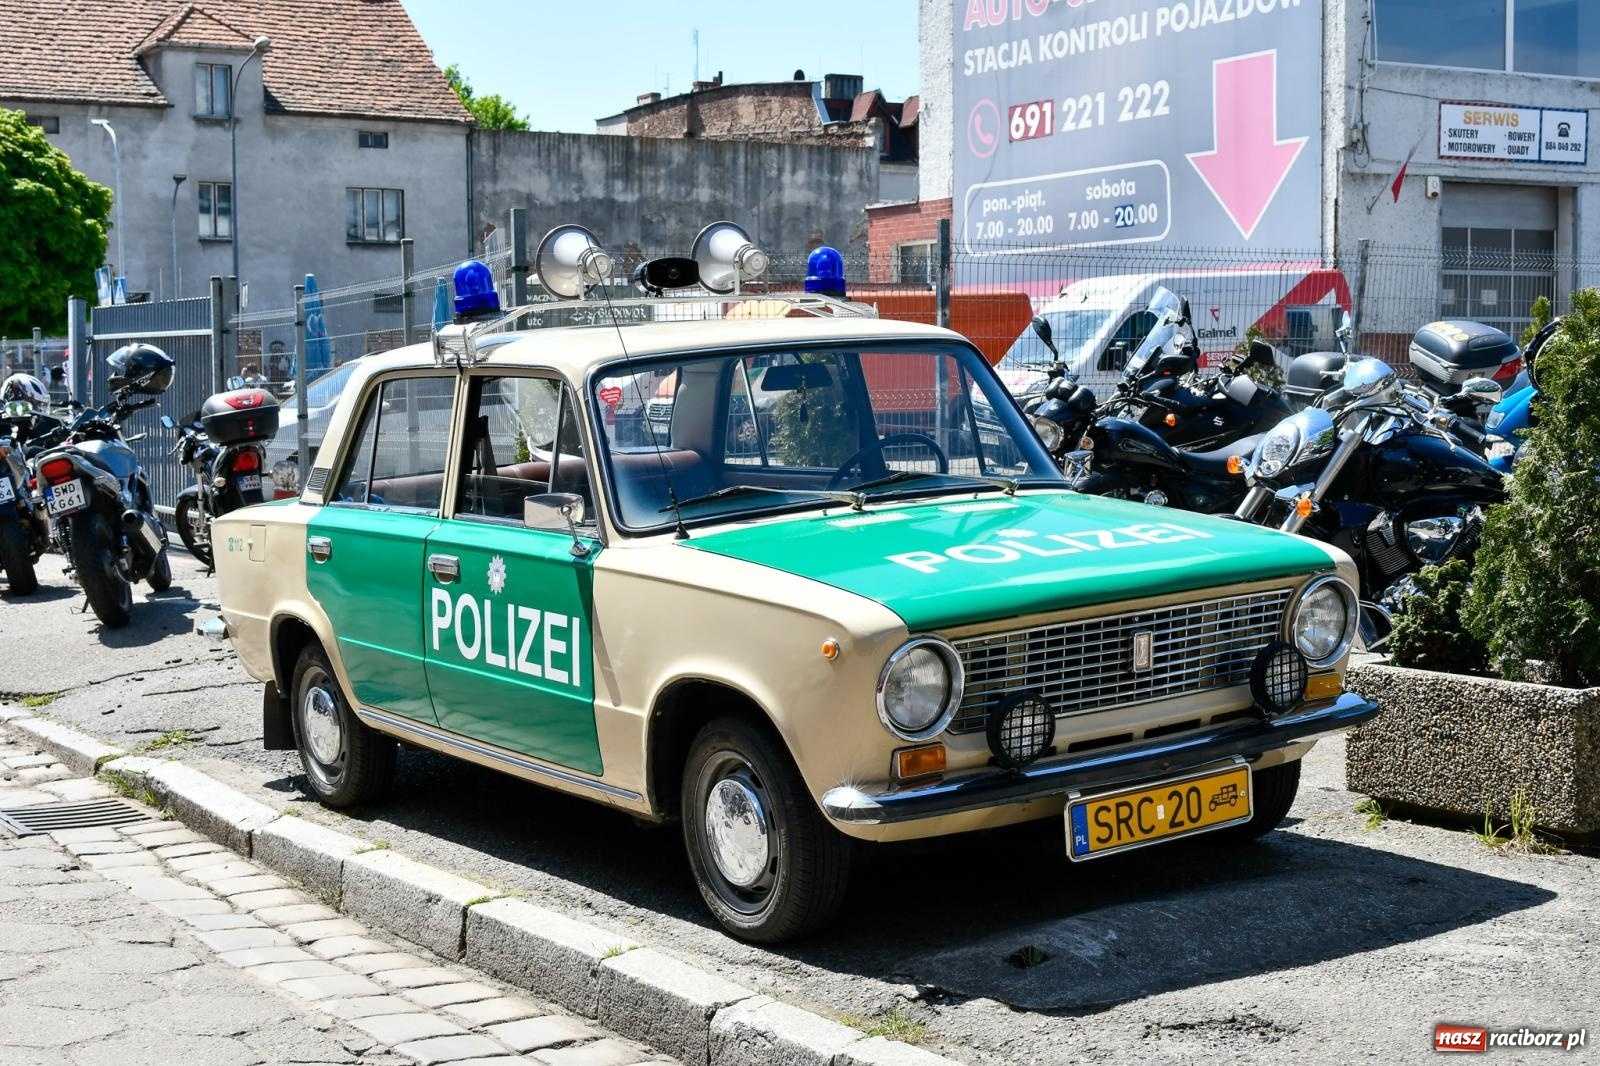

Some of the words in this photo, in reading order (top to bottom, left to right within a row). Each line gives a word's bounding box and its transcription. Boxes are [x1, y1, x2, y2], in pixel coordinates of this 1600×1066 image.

[964, 39, 1033, 77] STACJA
[1039, 11, 1148, 62] KONTROLI
[1010, 101, 1052, 140] 691
[1061, 91, 1105, 132] 221
[1117, 79, 1170, 123] 222
[1463, 110, 1519, 128] SERWIS
[1448, 128, 1479, 139] SKUTERY
[1507, 131, 1536, 142] ROWERY
[1448, 142, 1496, 154] MOTOROWERY
[1507, 145, 1529, 155] QUADY
[1086, 178, 1136, 200] sobota
[975, 222, 1004, 240] 7.00
[1017, 215, 1054, 236] 20.00
[1068, 209, 1098, 231] 7.00
[1115, 203, 1158, 227] 20.00
[1197, 325, 1237, 338] Galmet
[54, 483, 76, 497] SWD
[50, 494, 82, 512] KG61
[883, 522, 1216, 574] POLIZEI
[431, 587, 580, 687] POLIZEI
[1094, 796, 1155, 844] SRC
[1167, 786, 1202, 829] 20
[1075, 836, 1087, 847] PL
